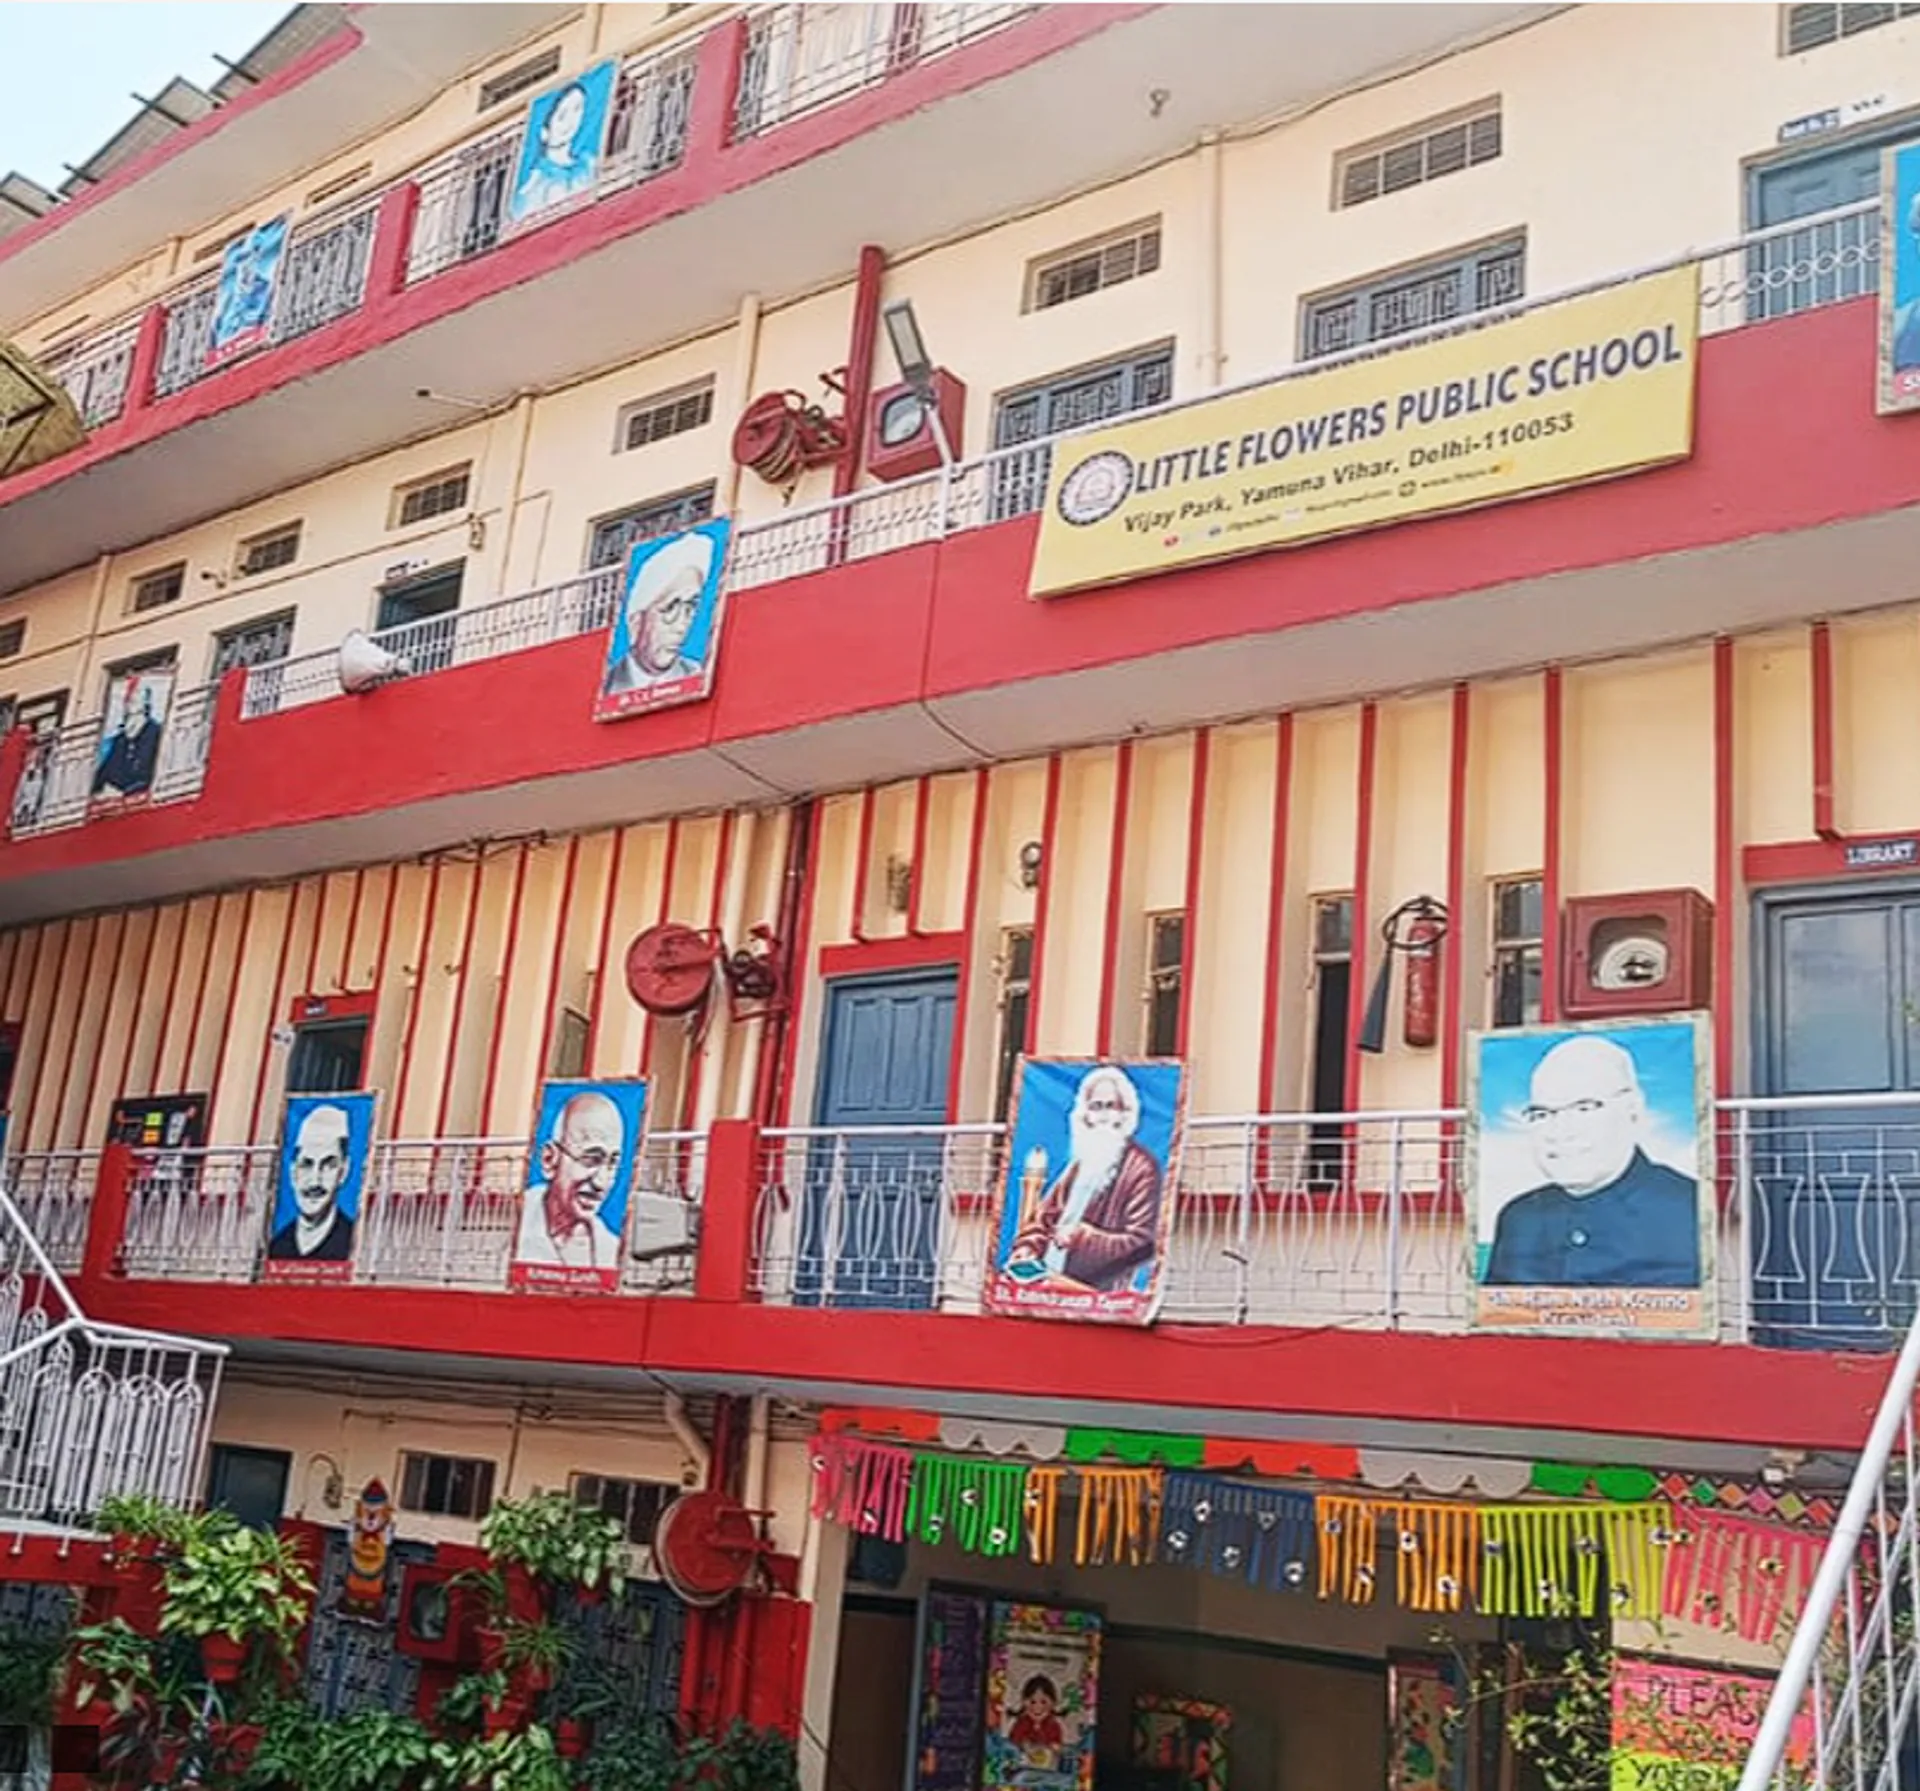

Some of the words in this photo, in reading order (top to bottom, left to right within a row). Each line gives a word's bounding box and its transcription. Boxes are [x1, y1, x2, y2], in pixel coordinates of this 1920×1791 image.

[1135, 440, 1231, 494] LITTLE
[1237, 401, 1387, 469] FLOWERS
[1396, 365, 1519, 431] PUBLIC
[1527, 324, 1682, 397] SCHOOL
[1124, 508, 1176, 534] Vijay
[1179, 495, 1232, 521] Park,
[1333, 460, 1399, 486] Vihar,
[1408, 410, 1576, 469] Delhi-110053
[1648, 1673, 1770, 1726] PLEAS
